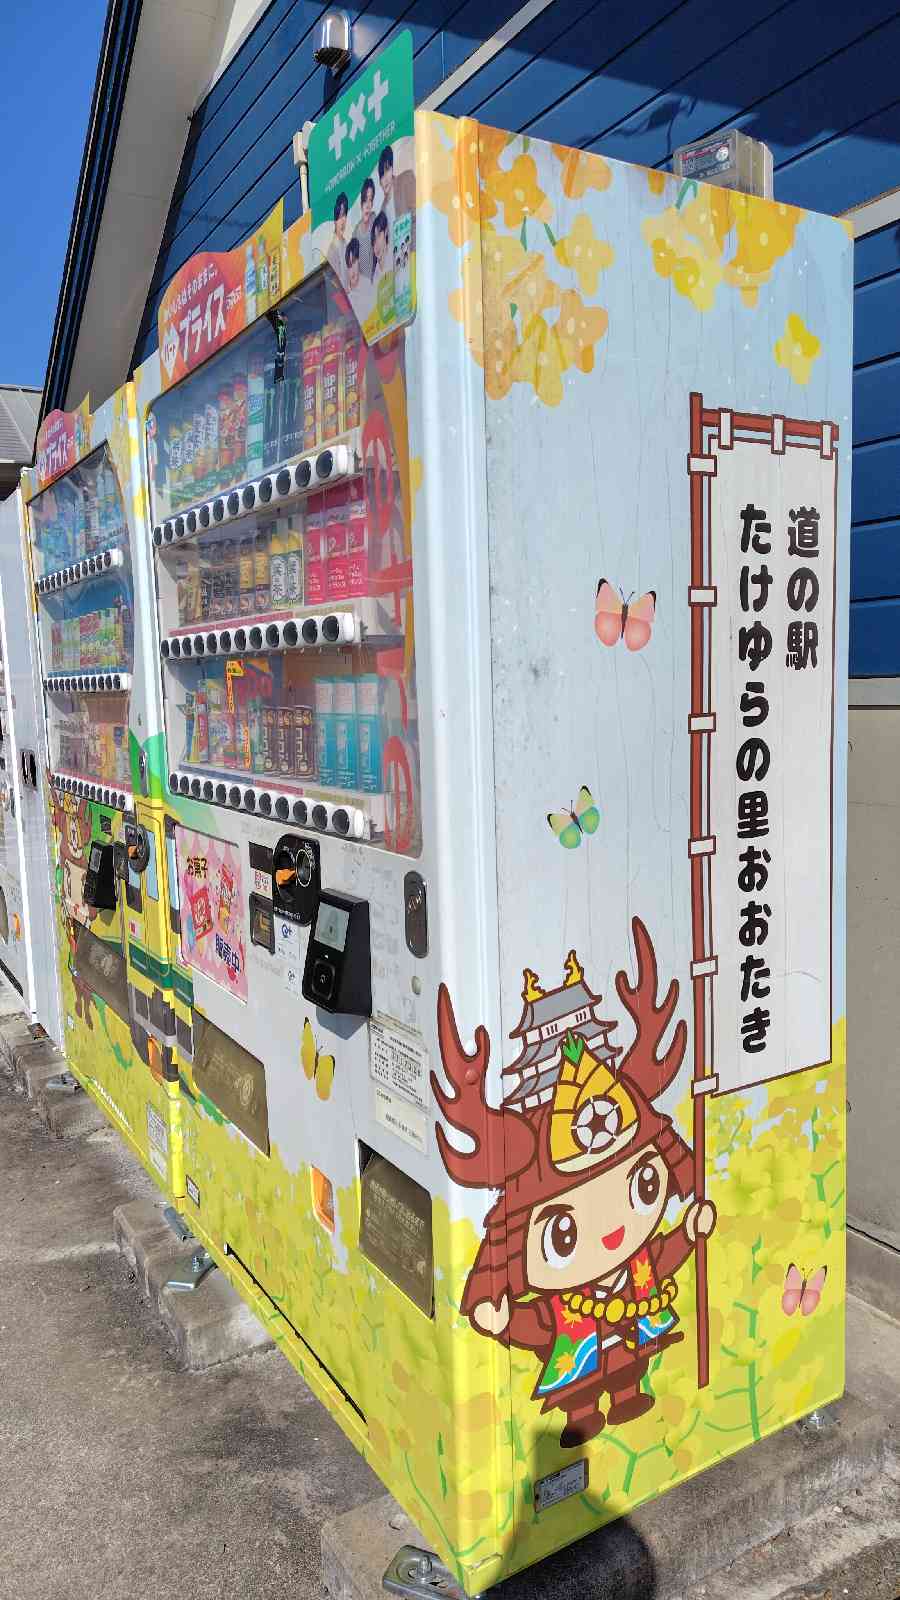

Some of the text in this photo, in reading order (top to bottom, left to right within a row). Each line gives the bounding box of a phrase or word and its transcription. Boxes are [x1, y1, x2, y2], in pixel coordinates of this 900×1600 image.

[179, 283, 227, 363] プライス
[786, 505, 821, 671] 道の駅
[736, 503, 774, 1053] たけゆらの里おおたき
[186, 855, 208, 879] お菓子
[215, 932, 241, 973] 販売中
